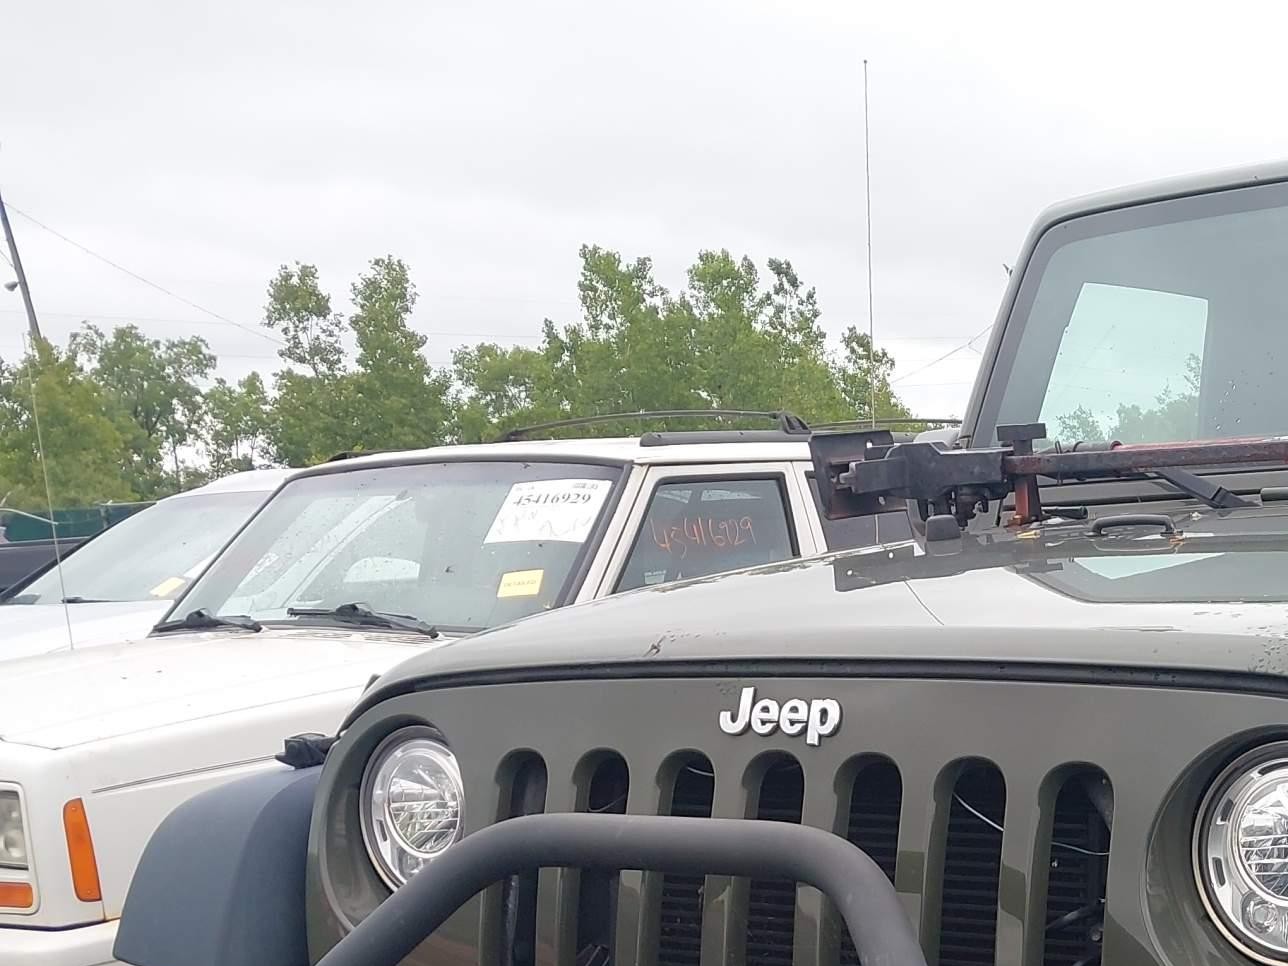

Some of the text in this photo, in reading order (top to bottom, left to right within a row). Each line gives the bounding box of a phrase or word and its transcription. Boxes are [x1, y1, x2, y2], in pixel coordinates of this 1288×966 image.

[513, 492, 592, 506] 45416929
[650, 515, 758, 560] 45416929
[719, 686, 842, 746] Jeep
